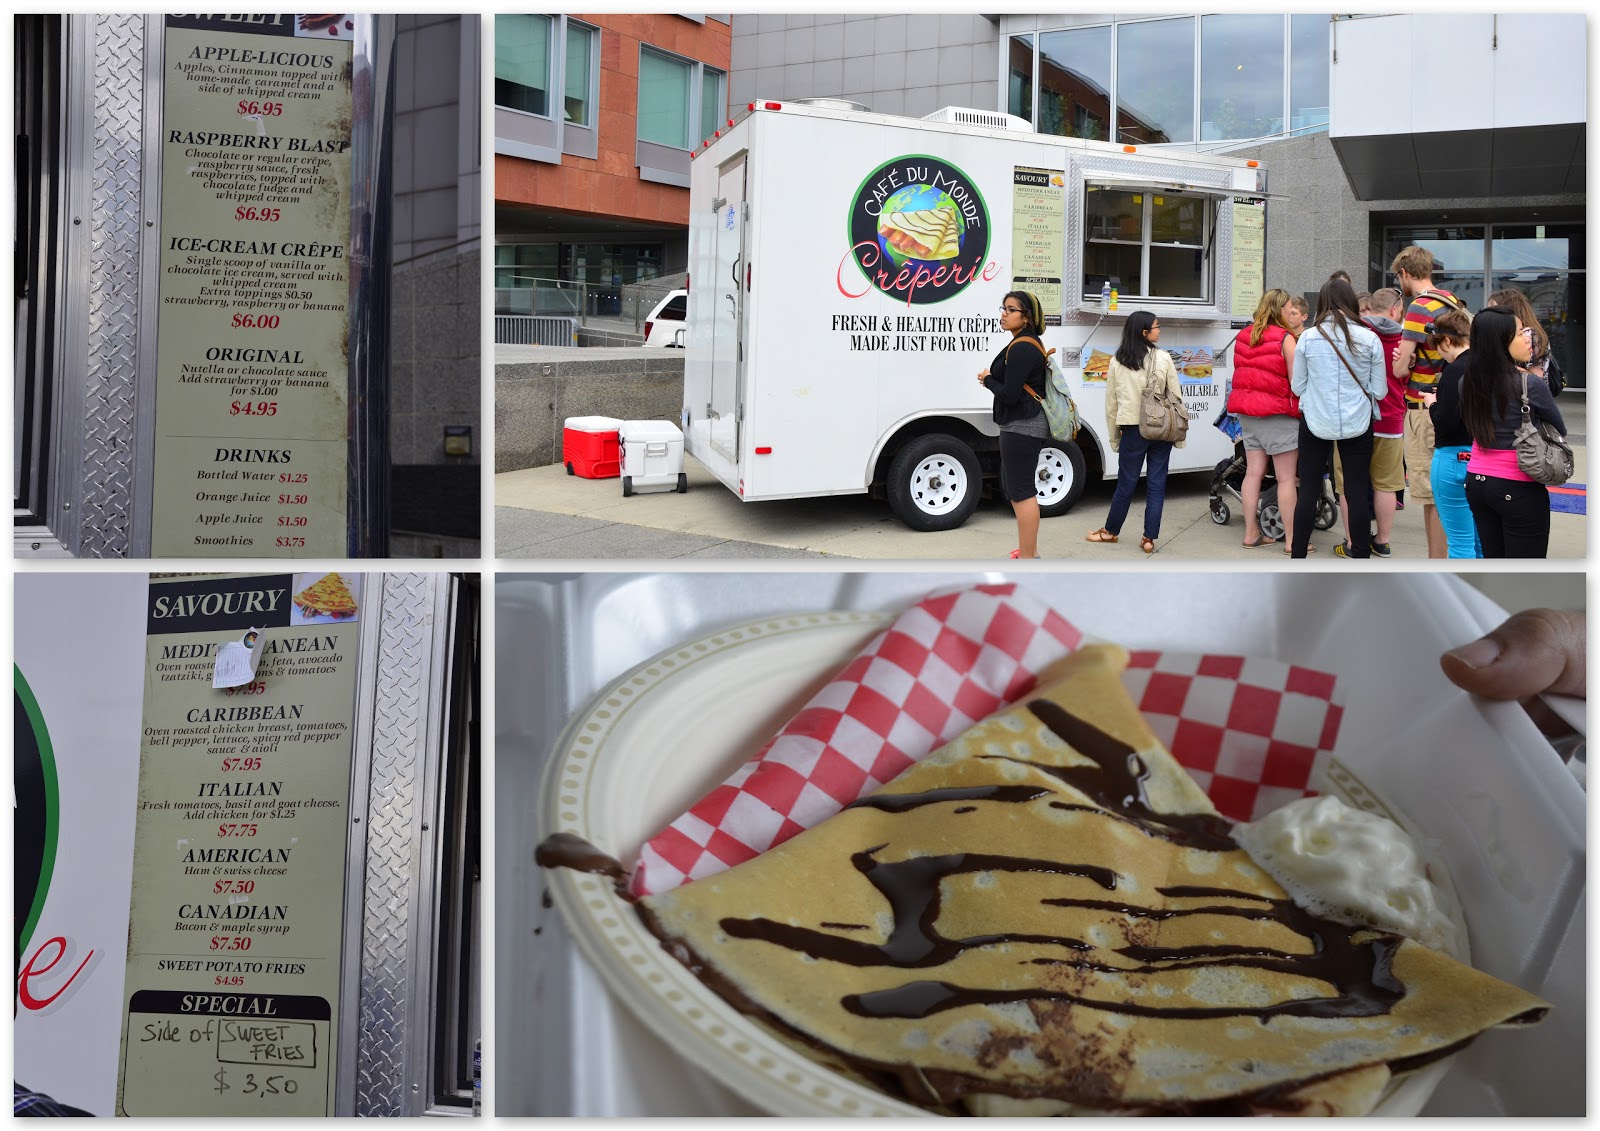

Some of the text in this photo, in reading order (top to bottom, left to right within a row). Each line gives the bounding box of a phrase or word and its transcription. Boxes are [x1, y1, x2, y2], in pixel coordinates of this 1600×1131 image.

[188, 46, 333, 69] APPLE-LICIOUS
[175, 61, 347, 82] Apples, Cinnamon topped with
[187, 72, 324, 90] home-made caramel and
[199, 84, 321, 100] side whipped cream
[237, 99, 283, 117] $6.95
[169, 130, 348, 154] RASPBERRY BLAST
[185, 149, 240, 160] Chocolate
[257, 154, 298, 165] regular
[198, 161, 319, 176] raspberry sauce, fresh
[191, 170, 325, 185] raspberries, topped with
[1015, 174, 1048, 183] SAVOURY
[203, 180, 313, 194] chocolate fudge and
[864, 168, 903, 216] CAFÉ
[907, 167, 927, 181] DU
[216, 191, 300, 203] whipped cream
[234, 205, 280, 222] $6.95
[169, 237, 343, 259] ICE-CREAM CRÊPE
[186, 256, 311, 270] Single scoop of vanilla
[168, 266, 221, 275] chocolate
[241, 270, 278, 279] cream,
[280, 272, 314, 280] served
[318, 273, 343, 281] with
[837, 240, 1002, 307] Crêperie
[213, 278, 297, 289] whipped cream
[200, 287, 312, 300] Extra toppings $0.50
[165, 296, 229, 308] strawberry,
[232, 300, 286, 310] raspberry
[303, 302, 345, 311] banana
[232, 312, 280, 329] $6.00
[832, 315, 877, 331] FRESH
[882, 316, 892, 331] &
[897, 316, 955, 333] HEALTHY
[850, 335, 989, 351] MADE JUST FOR YOU!
[205, 347, 304, 364] ORIGINAL
[181, 364, 225, 373] Nutella
[242, 366, 295, 377] chocolate
[178, 375, 330, 388] Add strawberry banana
[230, 386, 278, 397] for $1.00
[1180, 385, 1218, 396] VAILABLE
[229, 400, 277, 417] $4.95
[214, 448, 291, 464] DRINKS
[197, 470, 308, 483] Bottled Water $1.25
[196, 492, 307, 505] Orange Juice $1.50
[196, 514, 307, 527] Apple Juice $1.50
[194, 536, 305, 547] Smoothies $3.75
[153, 588, 286, 619] SAVOURY
[161, 636, 338, 660] MEDIANEAN
[156, 662, 216, 672] Oven roaste
[271, 657, 295, 670] feta,
[298, 654, 343, 665] avocado
[161, 671, 203, 682] tzatziki,
[288, 665, 337, 675] tomatoes
[186, 704, 304, 723] CARIBBEAN
[144, 721, 347, 736] Oven roasted chicken breast, tomatoes,
[150, 732, 341, 748] bell pepper, lettuce, spicy red pepper
[207, 743, 278, 754] sauce aioli
[221, 756, 262, 773] $7.95
[197, 781, 283, 797] ITALIAN
[142, 799, 340, 811] Fresh tomatoes, basil and goat cheese.
[183, 809, 295, 820] Add chicken for $1.25
[217, 823, 258, 838] $7.75
[182, 848, 292, 863] AMERICAN
[184, 866, 287, 875] Ham swiss cheese
[214, 879, 255, 894] $7.50
[178, 904, 289, 920] CANADIAN
[175, 922, 290, 935] Bacon maple syrup
[209, 936, 251, 951] $7.50
[158, 960, 305, 975] SWEET POTATO FRIES
[215, 976, 244, 985] $4.95
[180, 994, 276, 1015] SPECIAL
[190, 1020, 214, 1043] of
[221, 1022, 290, 1043] SWEET
[250, 1044, 304, 1061] FRIES
